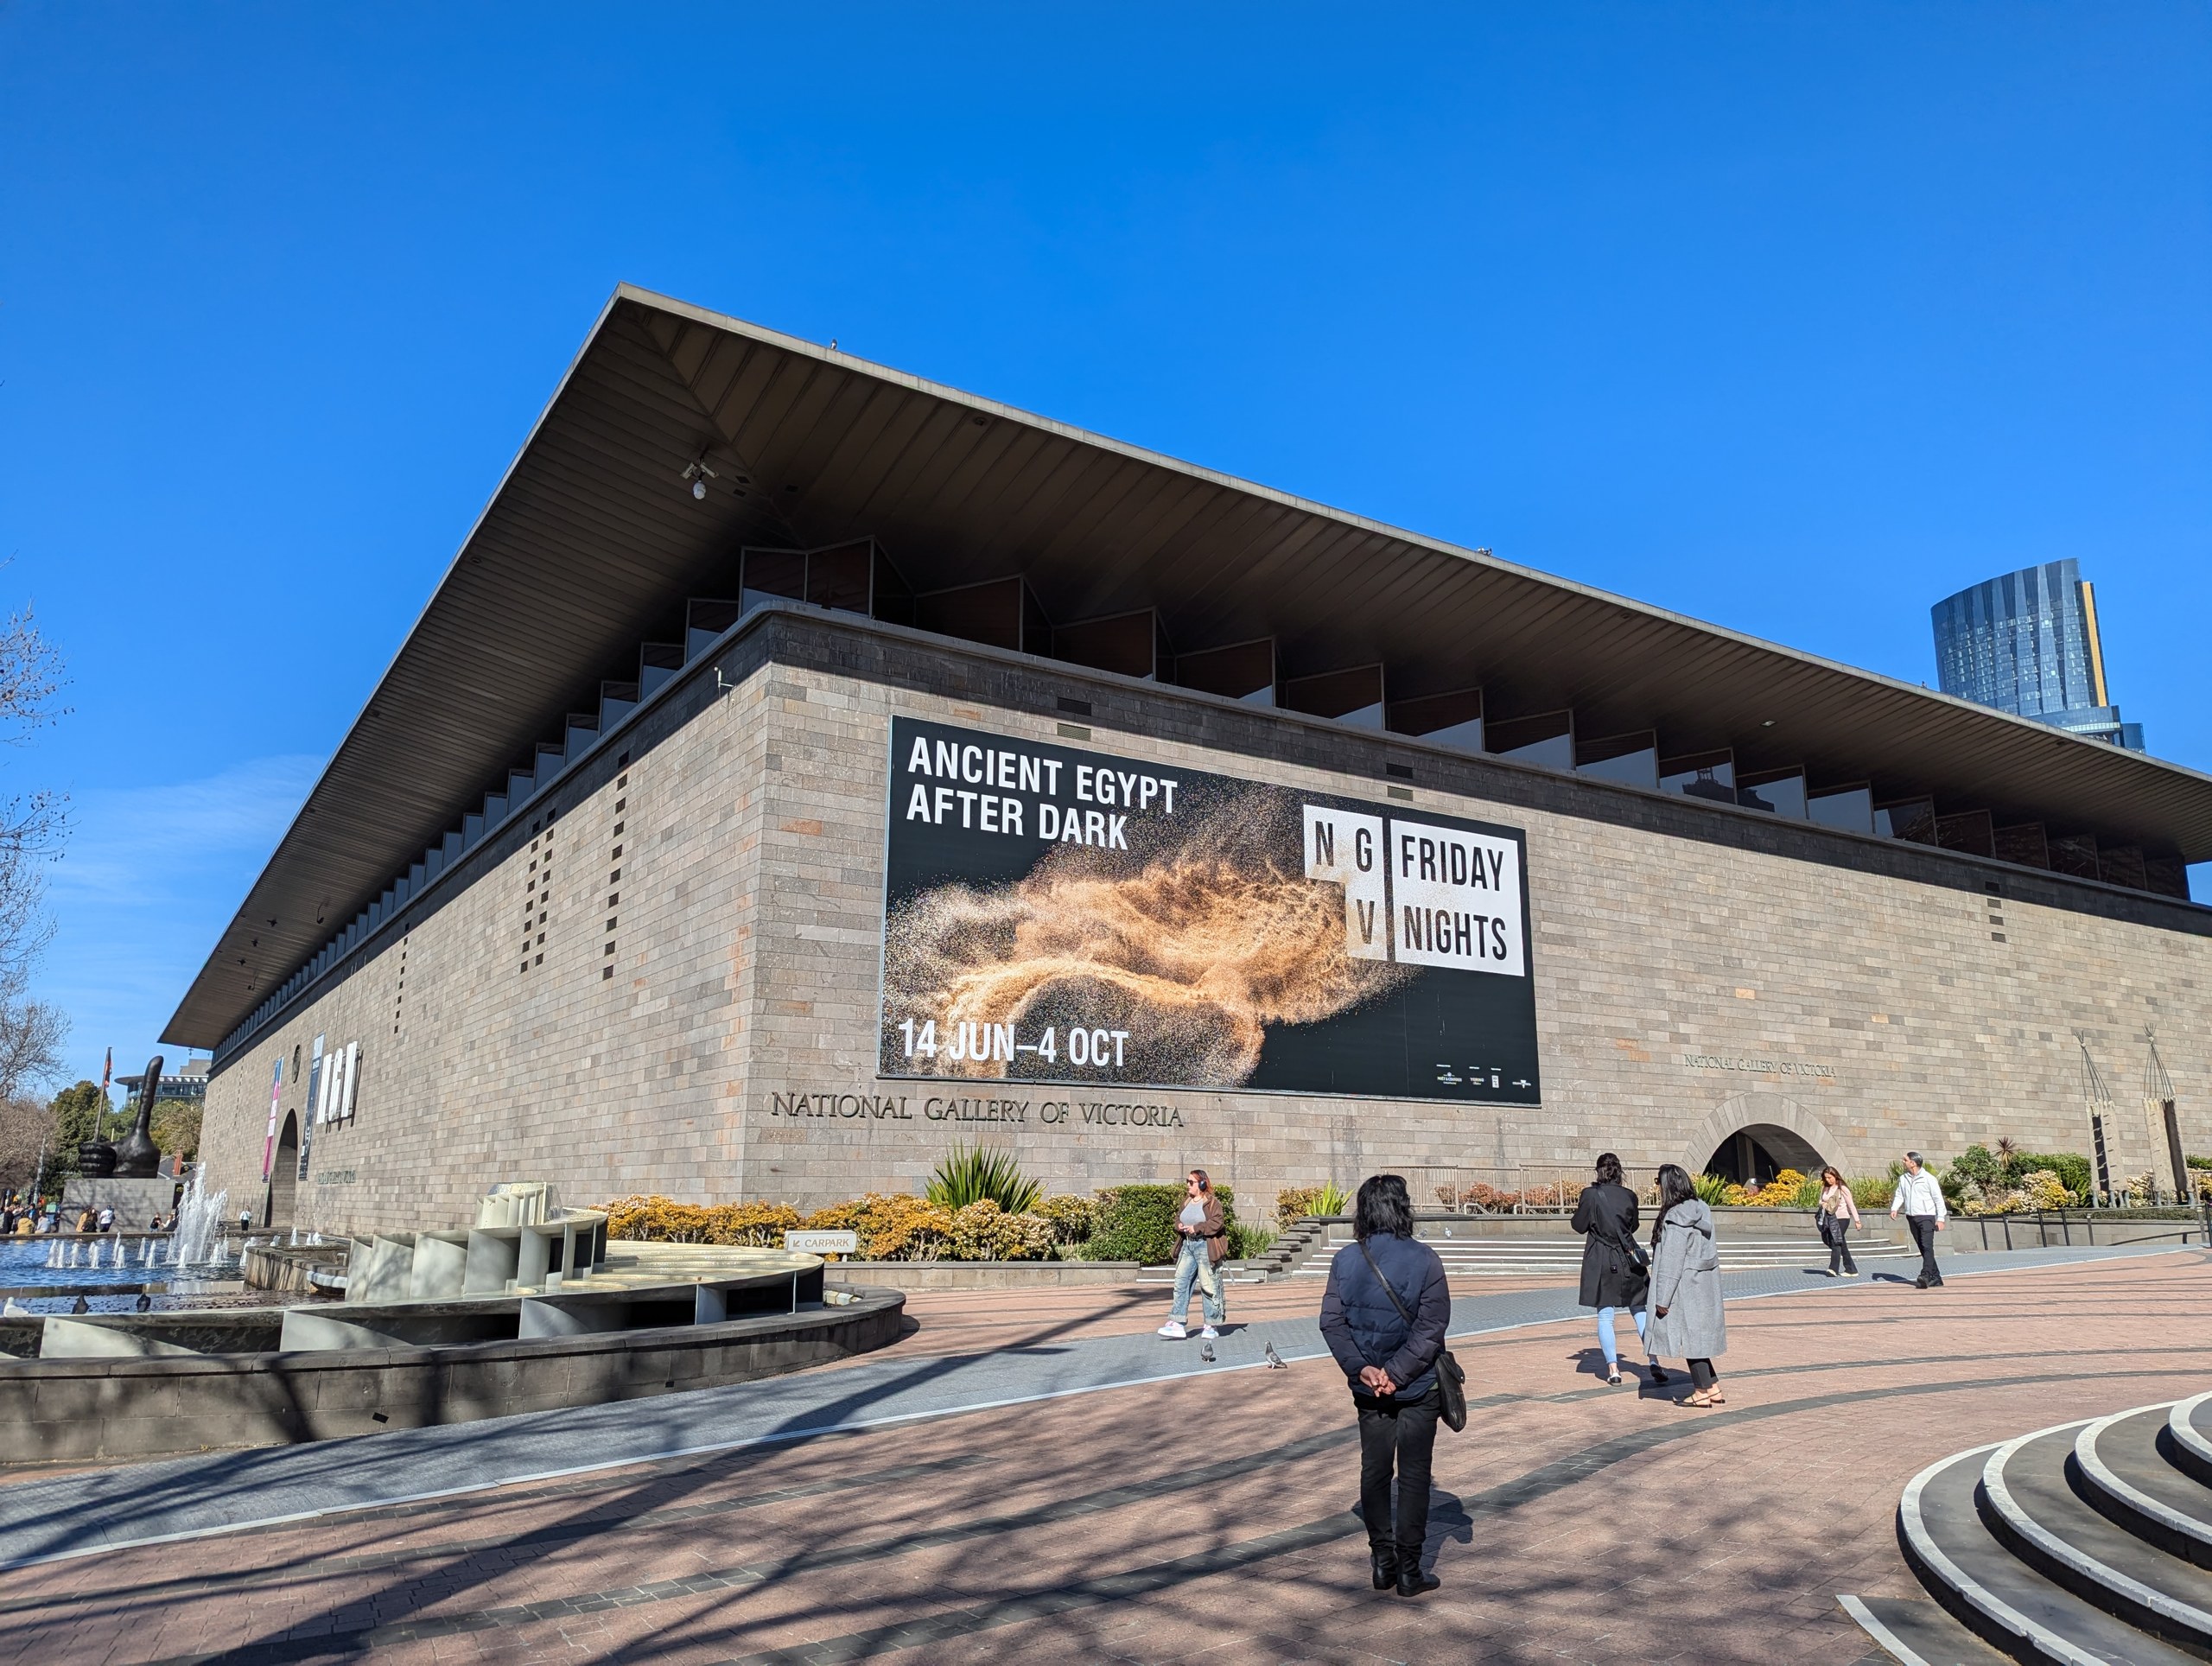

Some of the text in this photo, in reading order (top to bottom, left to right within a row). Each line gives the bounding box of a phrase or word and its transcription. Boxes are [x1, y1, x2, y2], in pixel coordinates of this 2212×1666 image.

[908, 737, 1178, 814] ANCIENT EGYPT
[906, 784, 1128, 850] AFTER DARK
[1402, 835, 1503, 891] FRIDAY
[1357, 899, 1375, 944] V
[1403, 905, 1508, 961] NIGHTS
[899, 1018, 937, 1057] 14
[1070, 1027, 1129, 1066] OCT
[1685, 1054, 1837, 1078] NATIONAL GALLERY OF VICTORIA
[772, 1091, 1185, 1127] NATIONAL GALLERY OF VICTORIA
[804, 1238, 849, 1248] CARPARK
